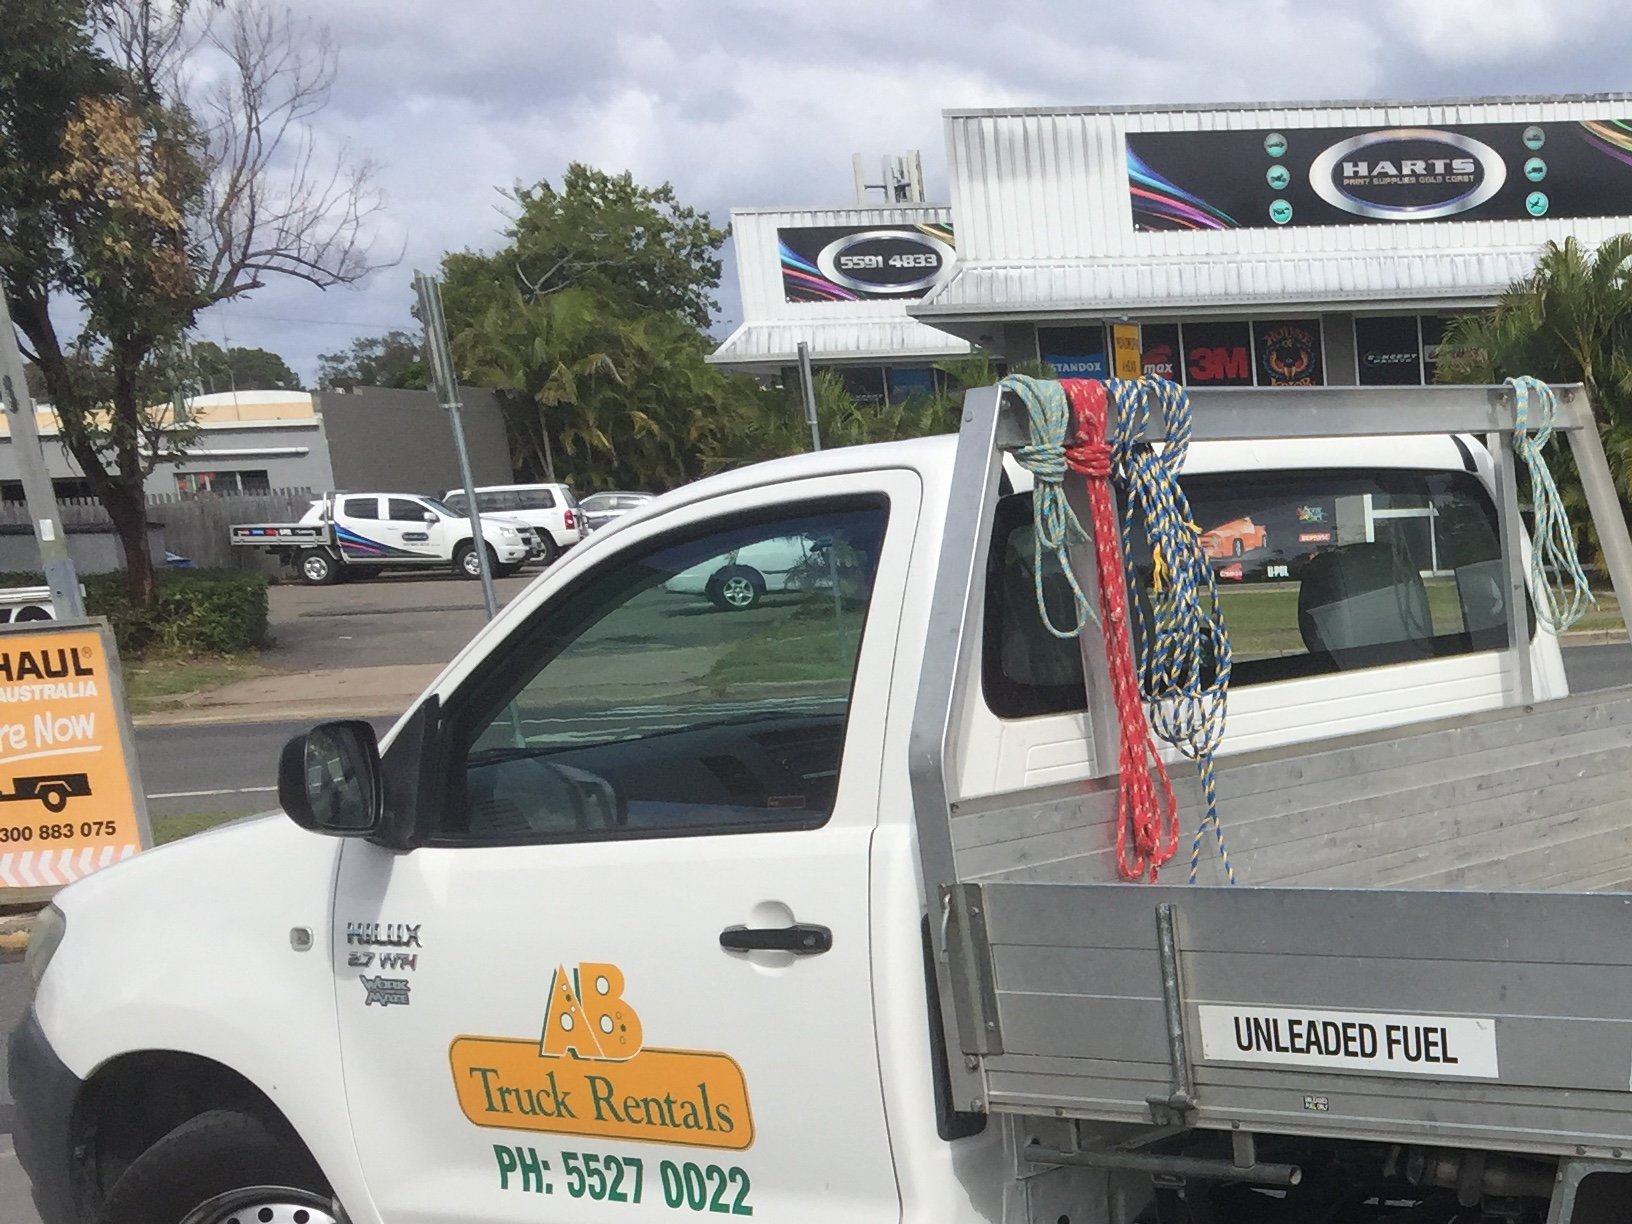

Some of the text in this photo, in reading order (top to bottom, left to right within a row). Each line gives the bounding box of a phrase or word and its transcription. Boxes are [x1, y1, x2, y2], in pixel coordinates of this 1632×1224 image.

[1342, 158, 1475, 177] HARTS
[1373, 176, 1416, 185] SUPPLIES
[1418, 175, 1443, 184] GOLD
[840, 254, 938, 269] 5591 4833
[1051, 362, 1102, 372] STANDOX
[1189, 347, 1249, 380] 3M
[0, 681, 98, 702] AUSTRALIA
[39, 824, 74, 841] 883
[80, 820, 117, 838] 075
[346, 922, 423, 948] HILUX
[1233, 1015, 1458, 1065] UNLEADED FUEL
[469, 1067, 735, 1134] Truck Rentals
[493, 1144, 754, 1216] PH: 5527 0022
